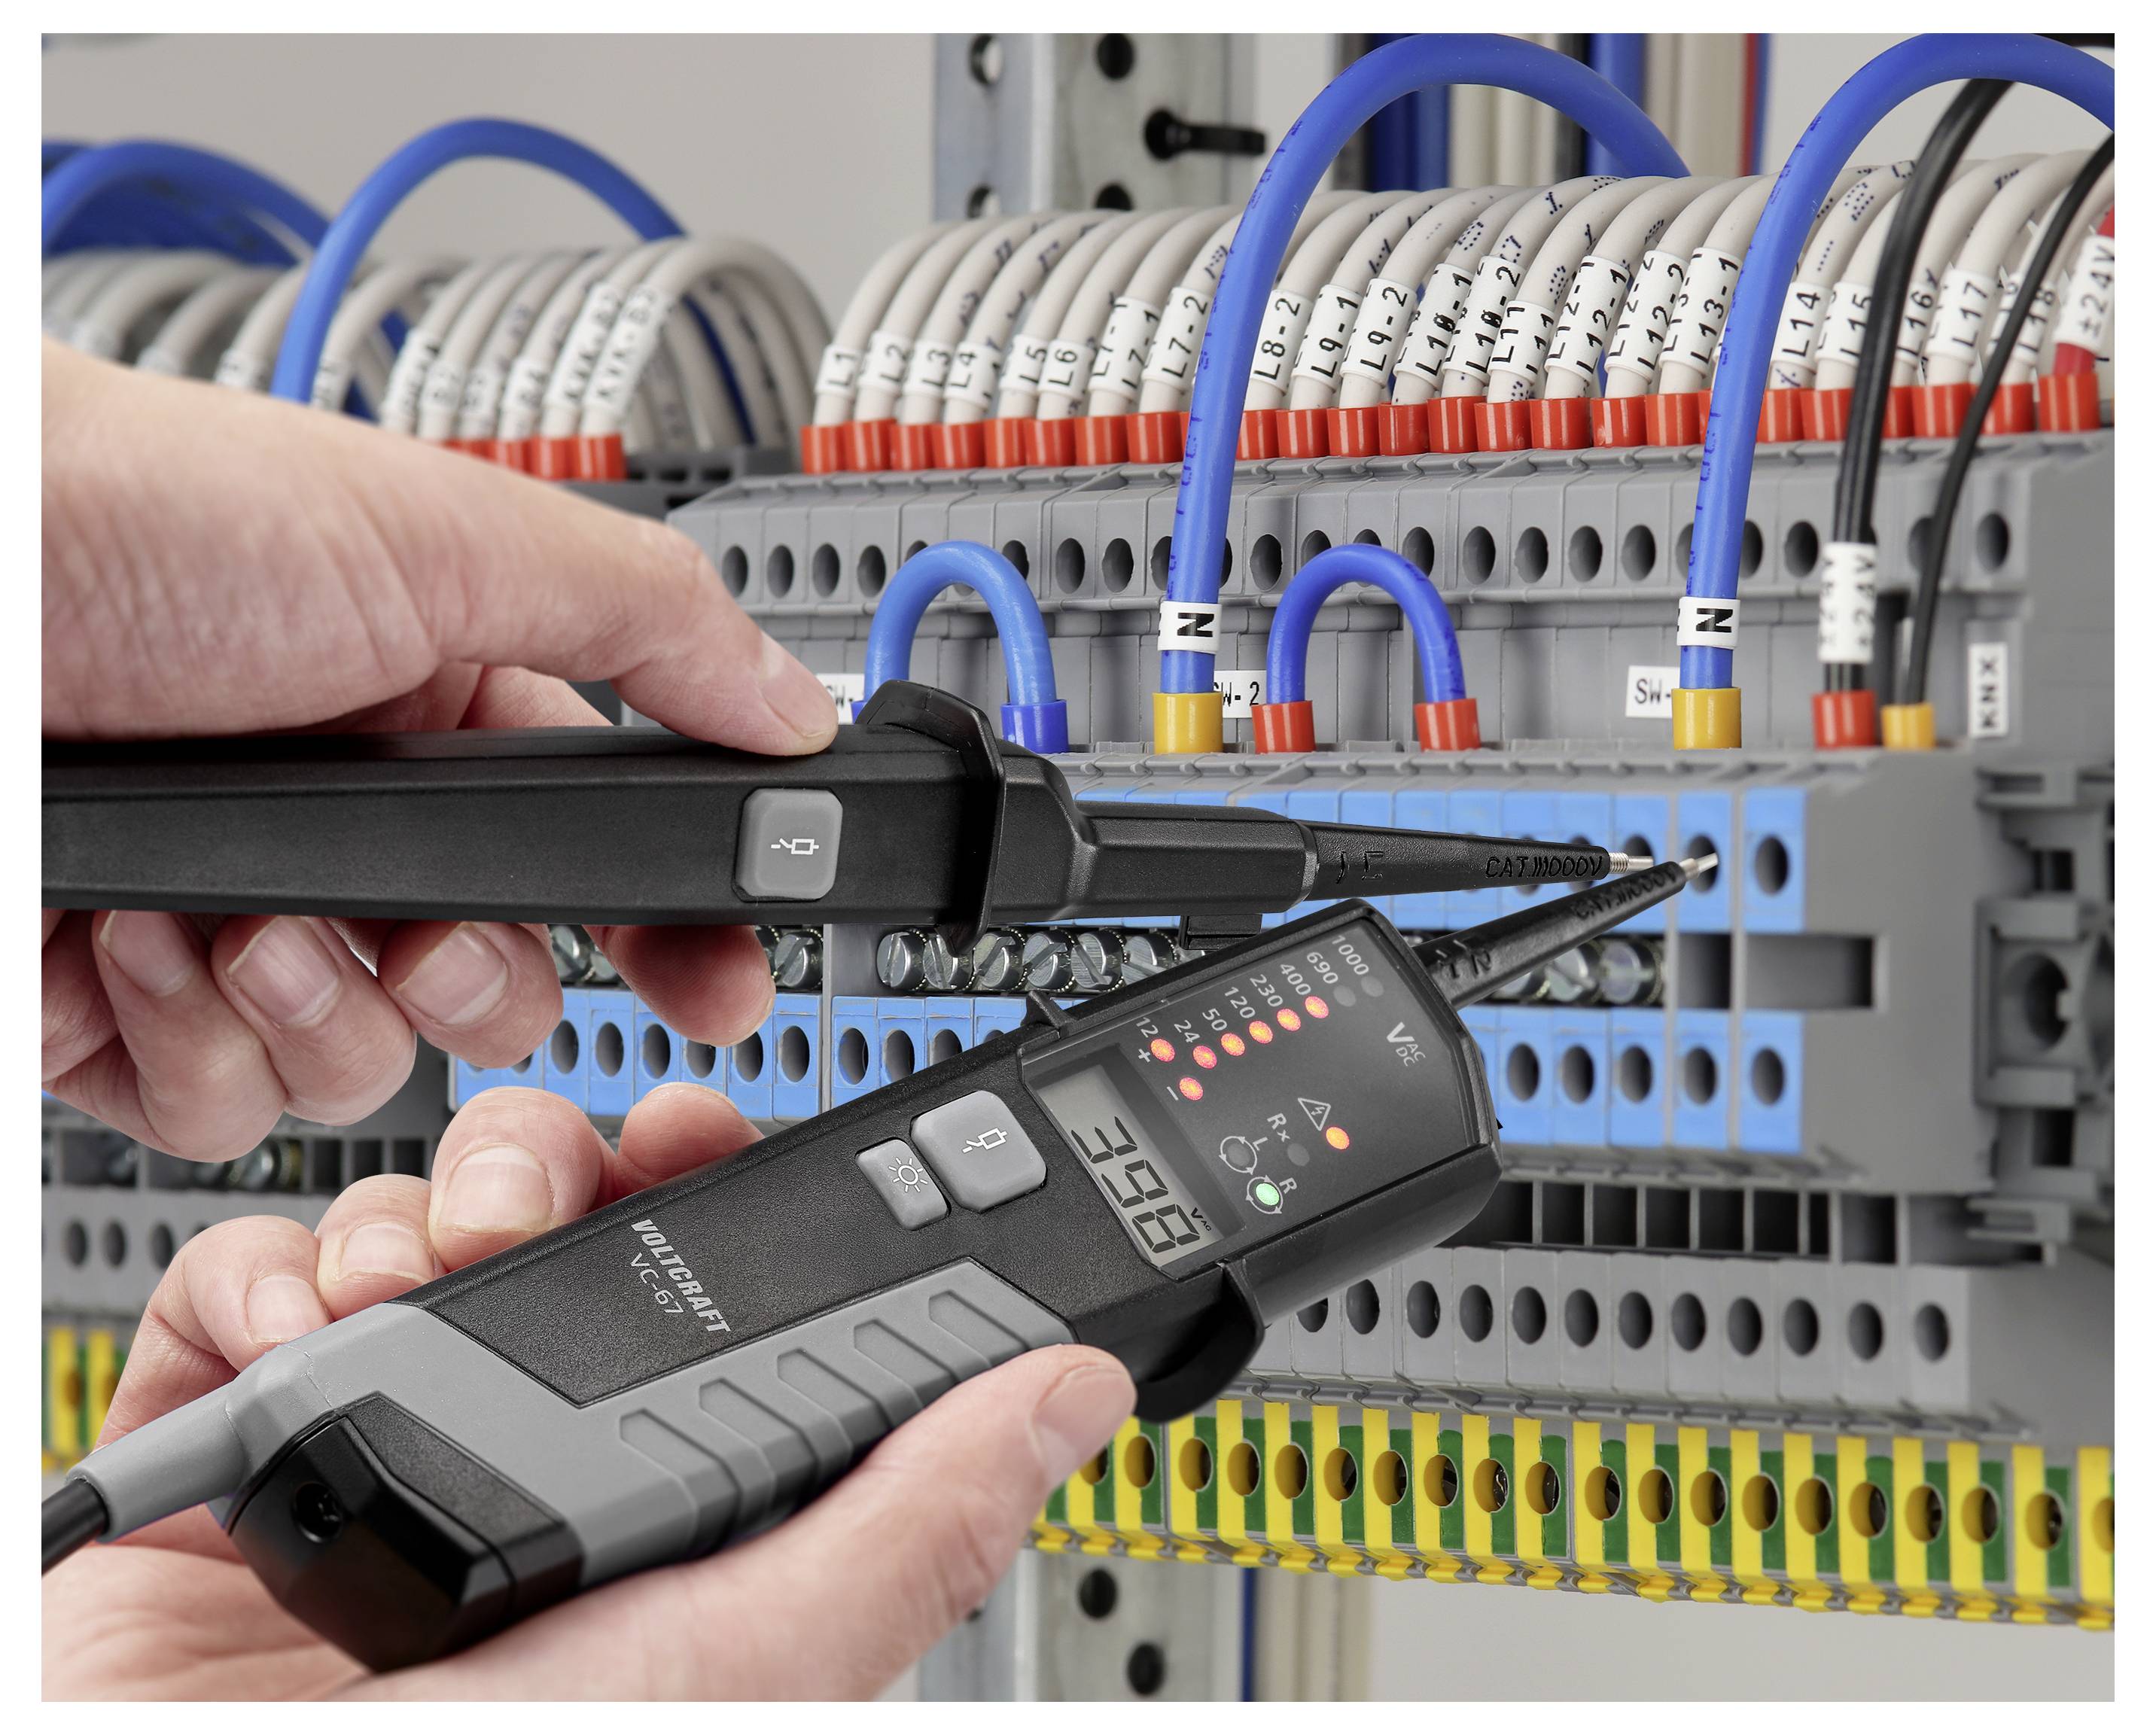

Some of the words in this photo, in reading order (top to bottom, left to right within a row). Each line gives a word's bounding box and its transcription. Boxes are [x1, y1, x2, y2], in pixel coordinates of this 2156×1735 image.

[1360, 287, 1408, 371] L9-2
[1415, 272, 1472, 376] L10-1
[1466, 266, 1520, 373] L10-2
[1576, 269, 1627, 373] L12-1
[1637, 263, 1685, 370] L12-2
[1690, 257, 1738, 364] L13-1
[1782, 292, 1820, 357] L14
[1896, 291, 1934, 357] L16
[1951, 281, 1988, 348] L17
[1162, 296, 1208, 378] L7-2
[1253, 297, 1301, 380] L8-2
[1311, 296, 1359, 378] L9-1
[1491, 307, 1525, 363] L11
[827, 353, 857, 386] L1
[879, 344, 909, 382] L2
[921, 349, 952, 387] L3
[949, 351, 977, 388] L4
[1019, 345, 1047, 384] L5
[1047, 349, 1078, 386] L6
[1177, 612, 1214, 638] N
[1696, 608, 1733, 633] N
[1977, 656, 1999, 729] KNX
[1306, 951, 1338, 985] 690
[1332, 934, 1369, 976] 1000
[1250, 973, 1284, 1007] 230
[1280, 963, 1312, 996] 400
[1202, 1008, 1228, 1031] 50
[1224, 986, 1256, 1018] 120
[1135, 1016, 1159, 1038] 12
[1174, 1019, 1201, 1044] 24
[1252, 1137, 1268, 1151] L
[1071, 1116, 1200, 1254] 398
[1278, 1177, 1298, 1195] R
[631, 1219, 731, 1332] VOLTCRAFT
[631, 1253, 684, 1313] VC-67
